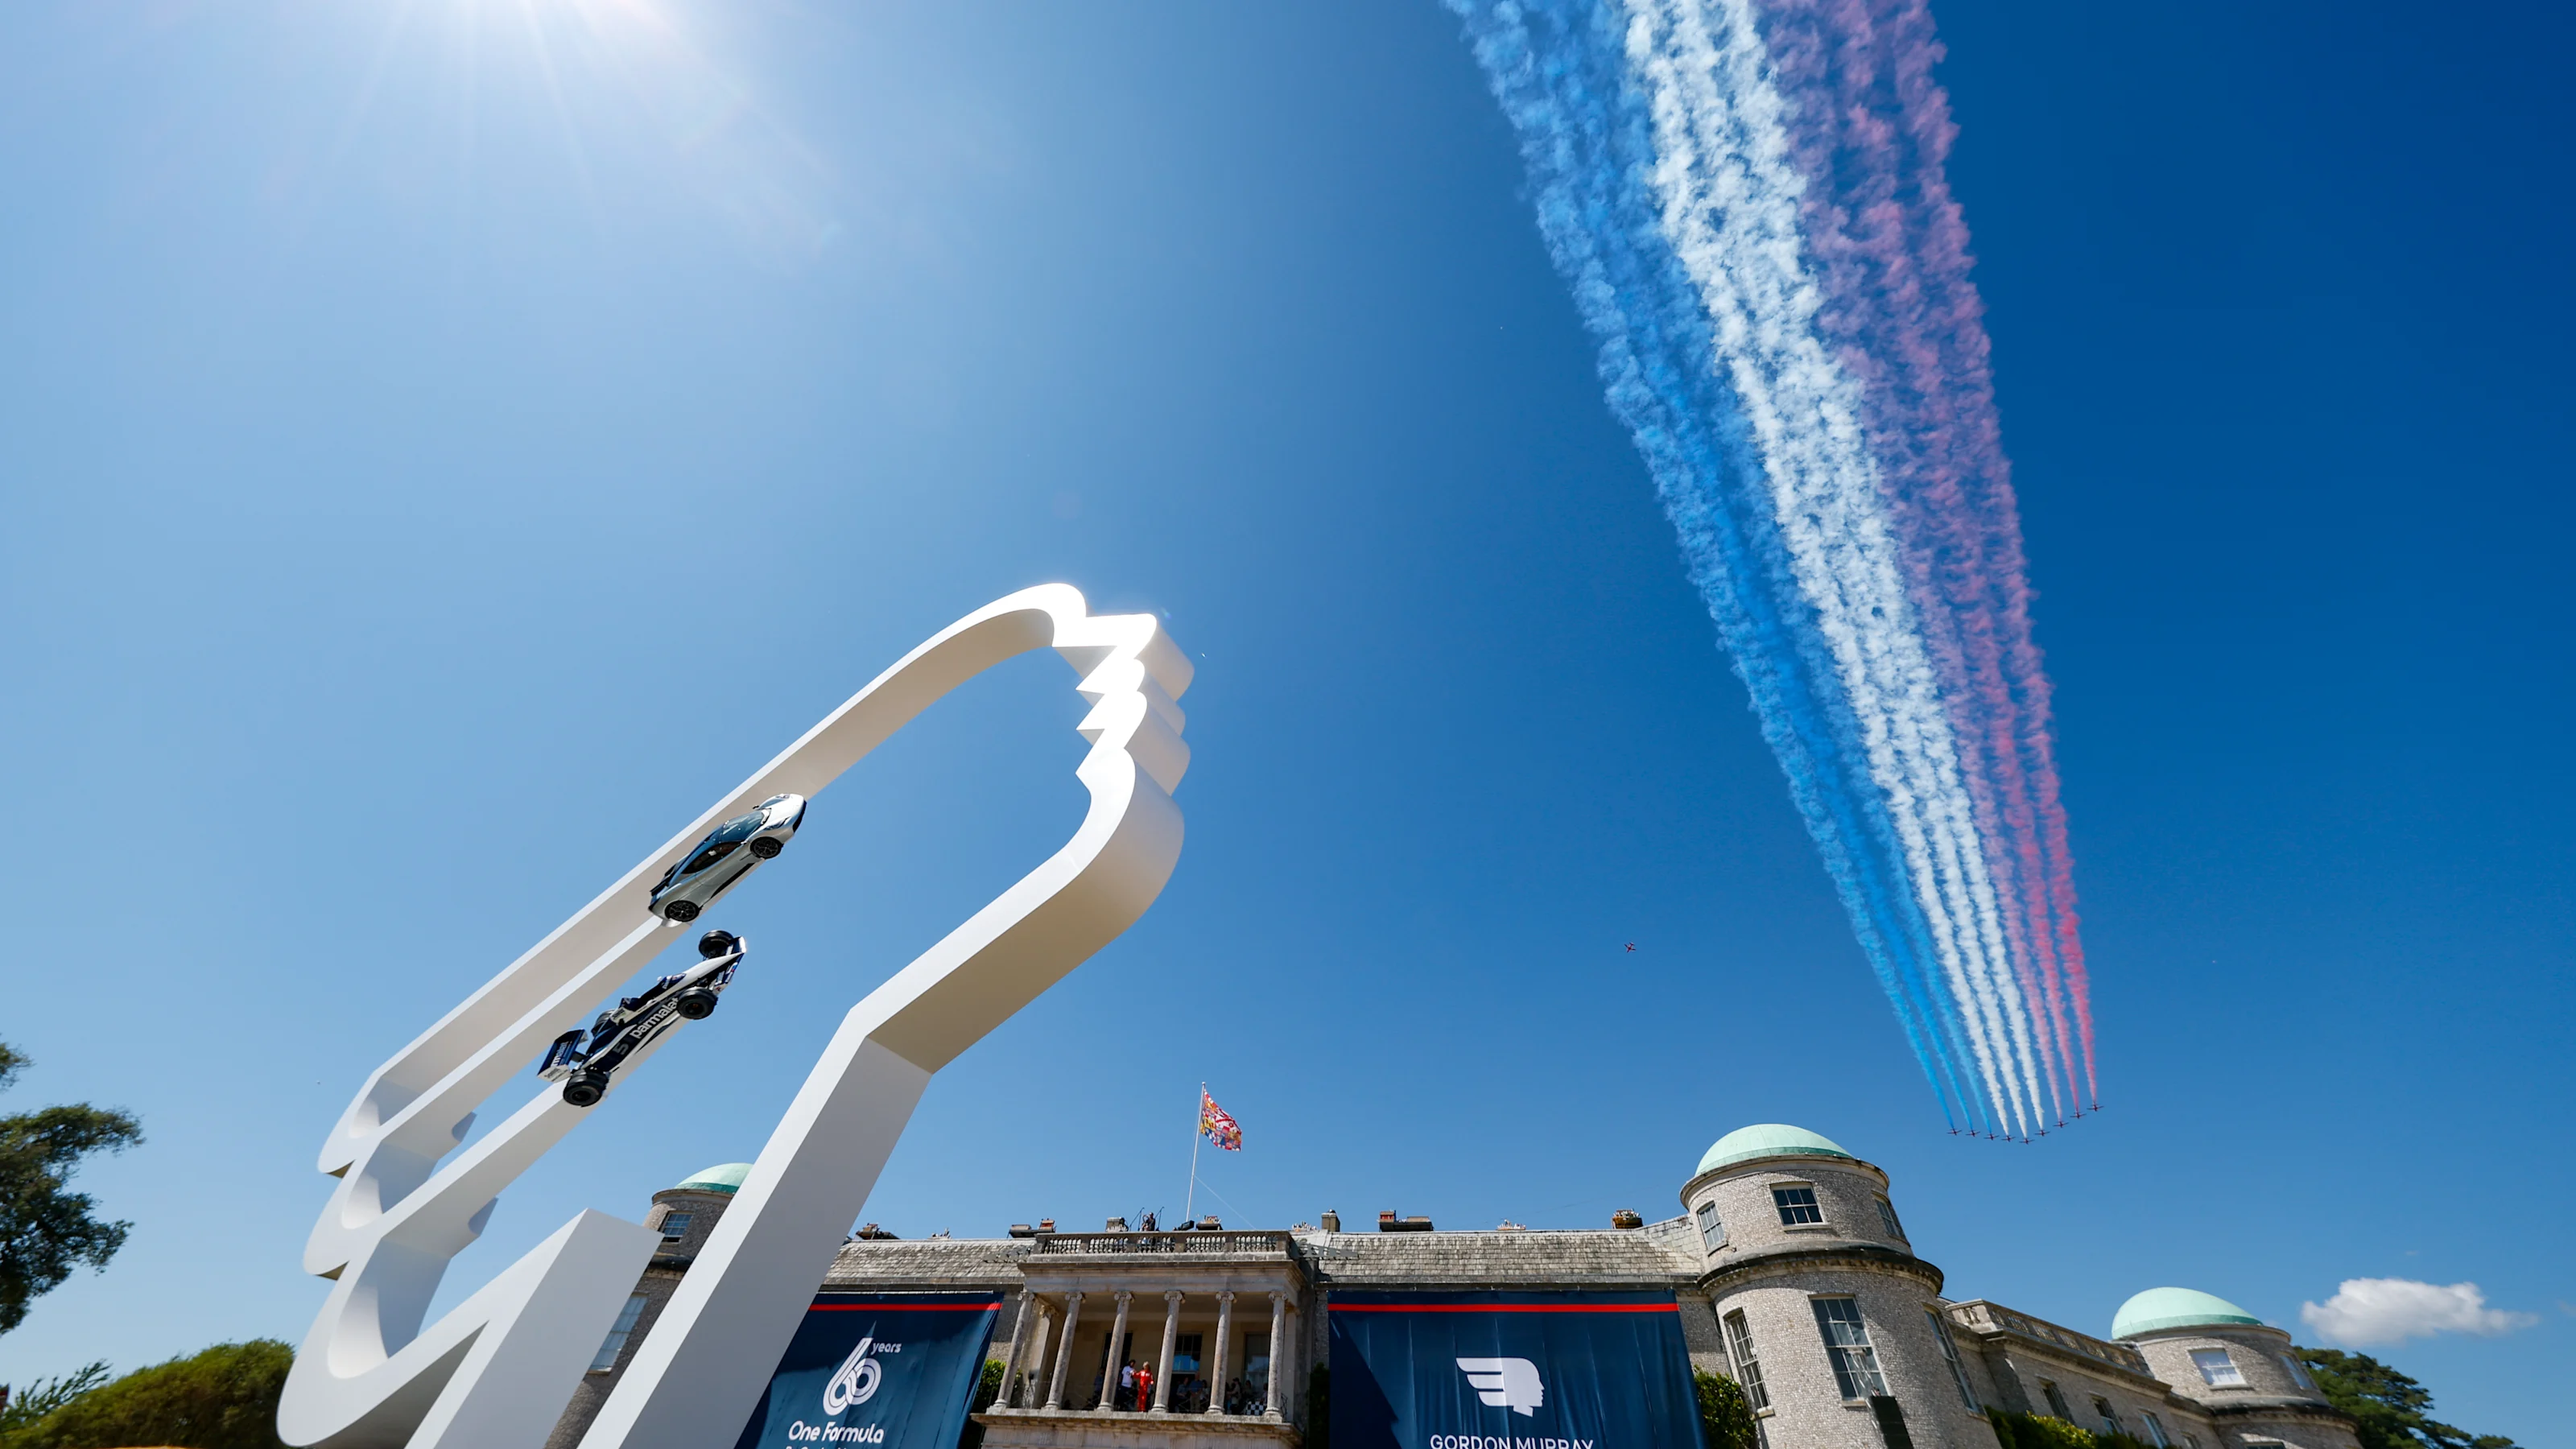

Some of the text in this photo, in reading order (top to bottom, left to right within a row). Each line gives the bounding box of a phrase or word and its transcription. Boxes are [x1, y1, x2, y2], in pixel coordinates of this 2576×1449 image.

[630, 997, 679, 1039] parmalat
[614, 1042, 629, 1055] 5
[870, 1343, 902, 1356] years
[788, 1420, 885, 1443] One Formula
[1430, 1434, 1594, 1449] GORDON MURRAY
